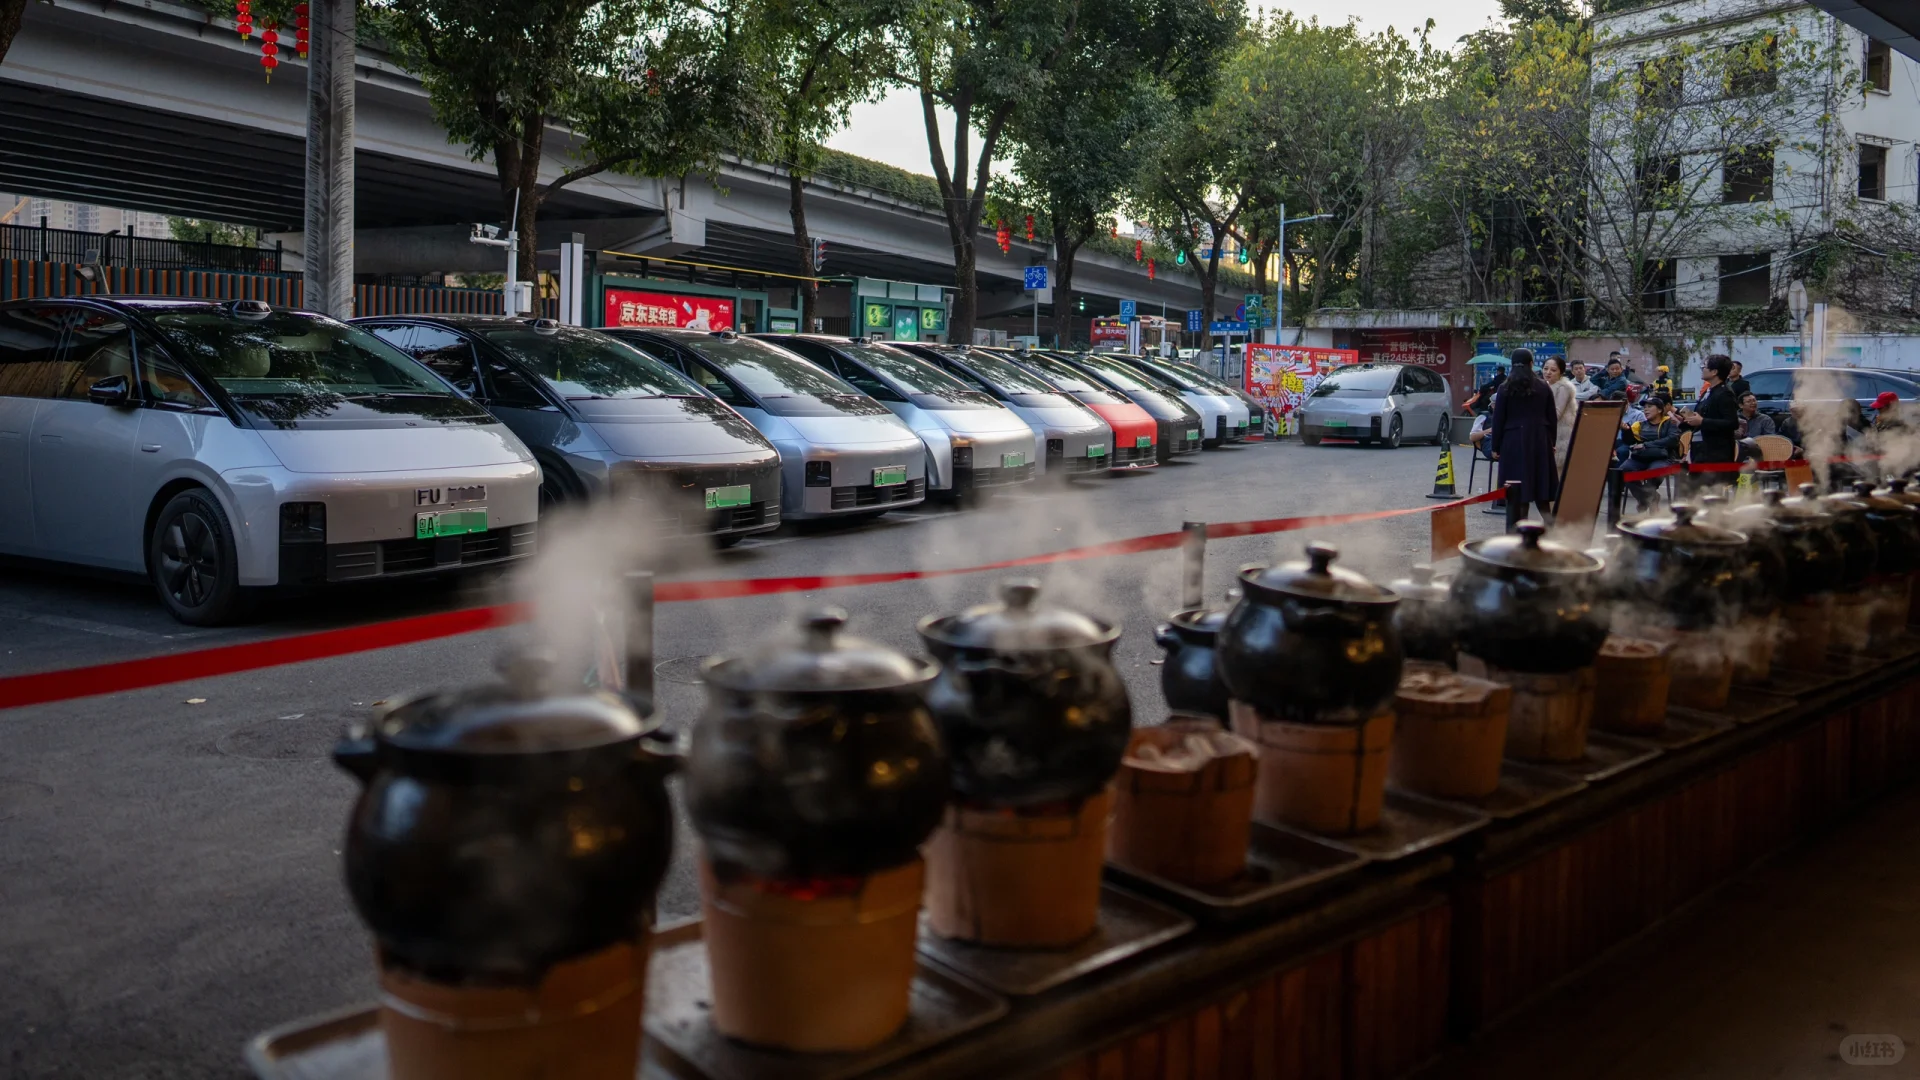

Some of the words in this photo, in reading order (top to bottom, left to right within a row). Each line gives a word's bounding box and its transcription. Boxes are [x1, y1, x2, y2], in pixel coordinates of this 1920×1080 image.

[621, 302, 677, 325] 京东买年货
[1390, 341, 1427, 352] 营销中心
[1373, 352, 1435, 364] 直行245米右转
[417, 488, 441, 505] FU
